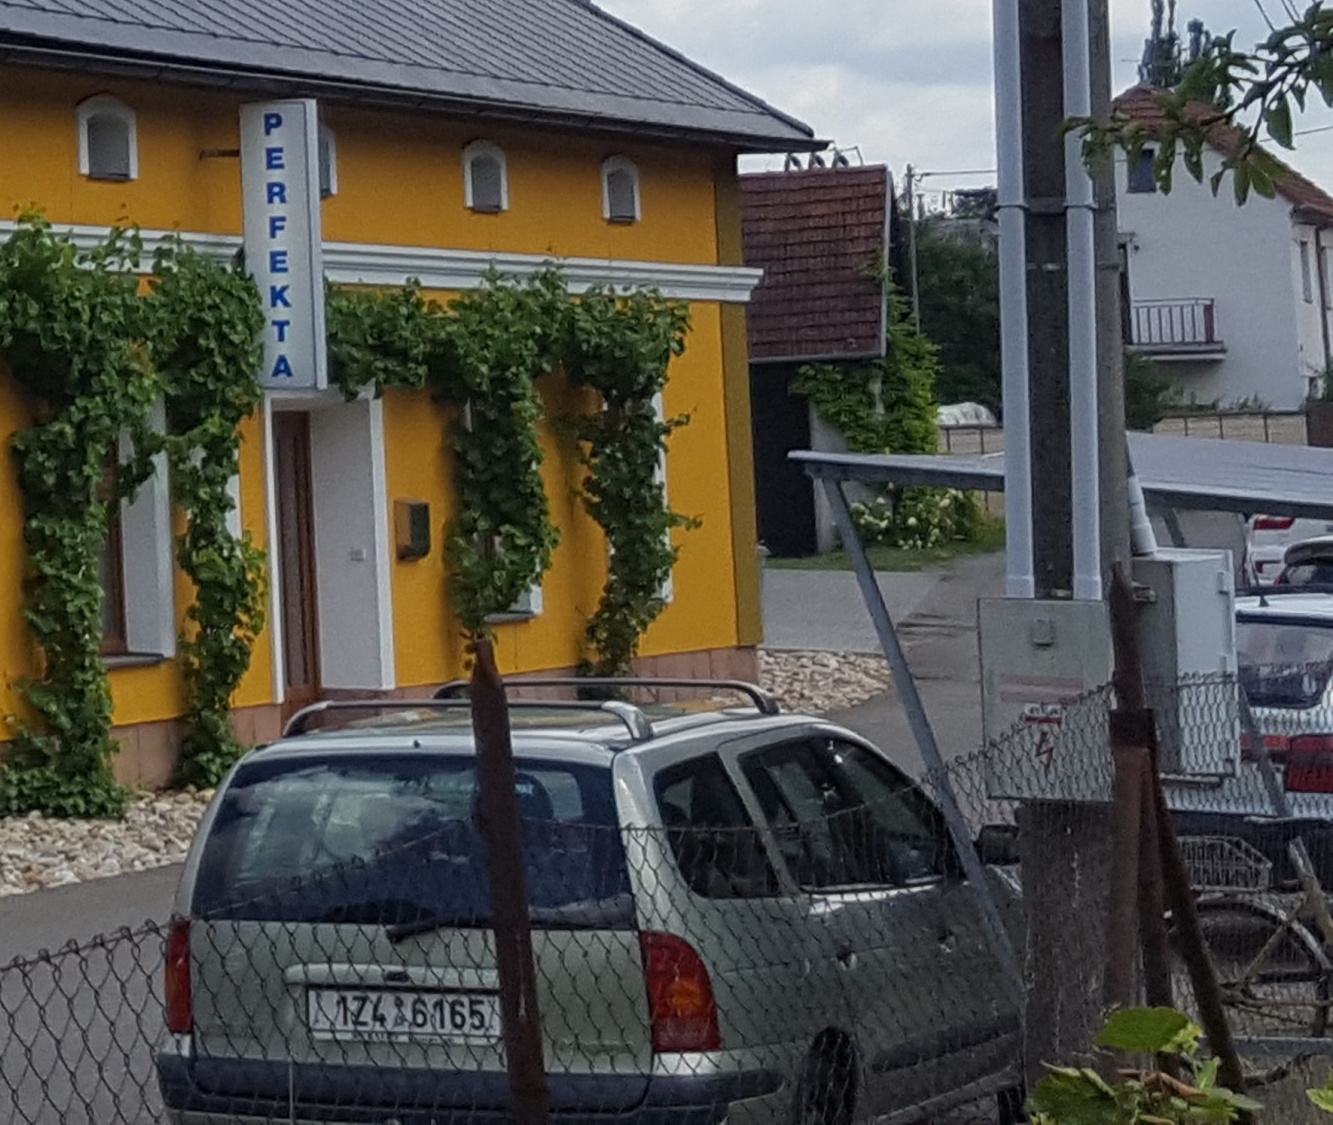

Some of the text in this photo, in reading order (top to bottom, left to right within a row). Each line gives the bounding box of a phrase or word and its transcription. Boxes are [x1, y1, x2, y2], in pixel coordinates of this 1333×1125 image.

[263, 112, 294, 378] PERFEKTA
[339, 995, 486, 1030] 1Z4 6165
